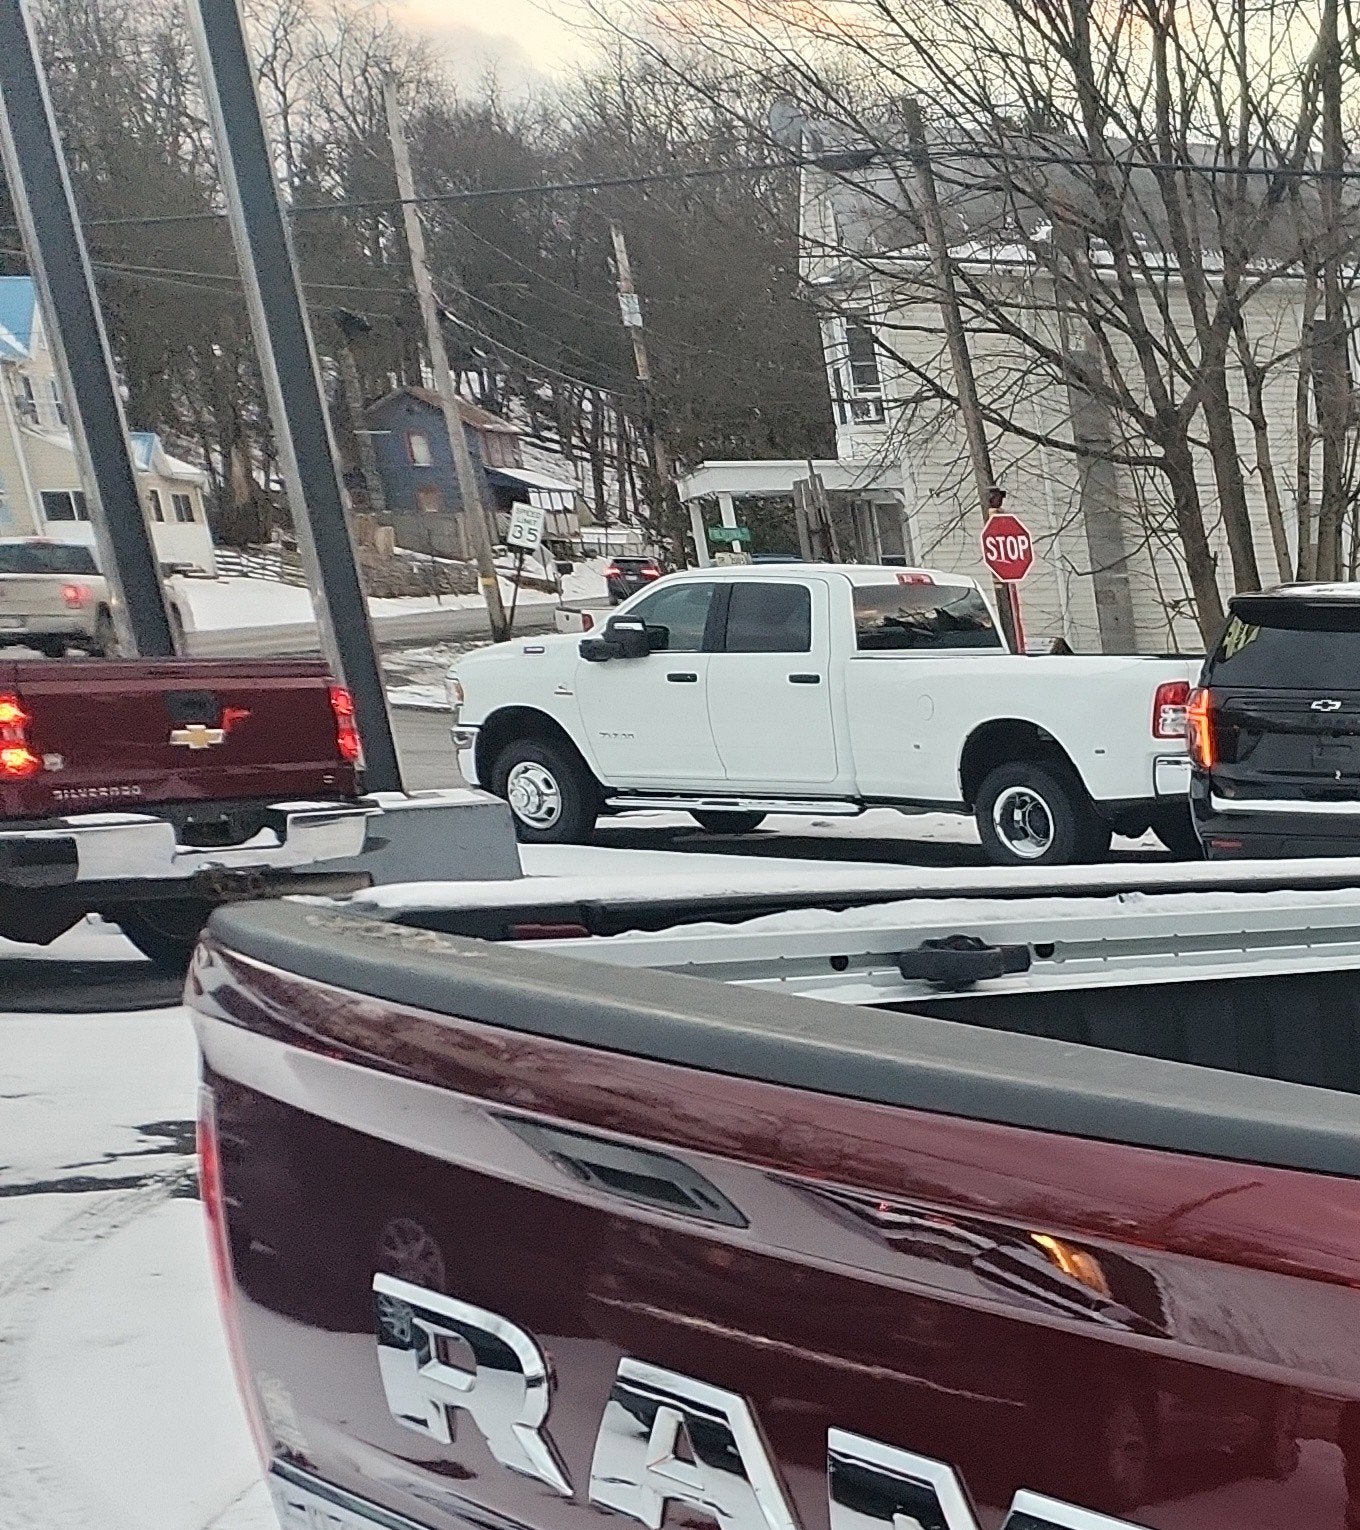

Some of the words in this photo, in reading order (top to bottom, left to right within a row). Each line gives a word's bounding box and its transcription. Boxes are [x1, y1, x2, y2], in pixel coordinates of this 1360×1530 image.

[512, 524, 539, 542] 35
[985, 535, 1029, 561] STOP
[52, 784, 142, 801] SILVERADO
